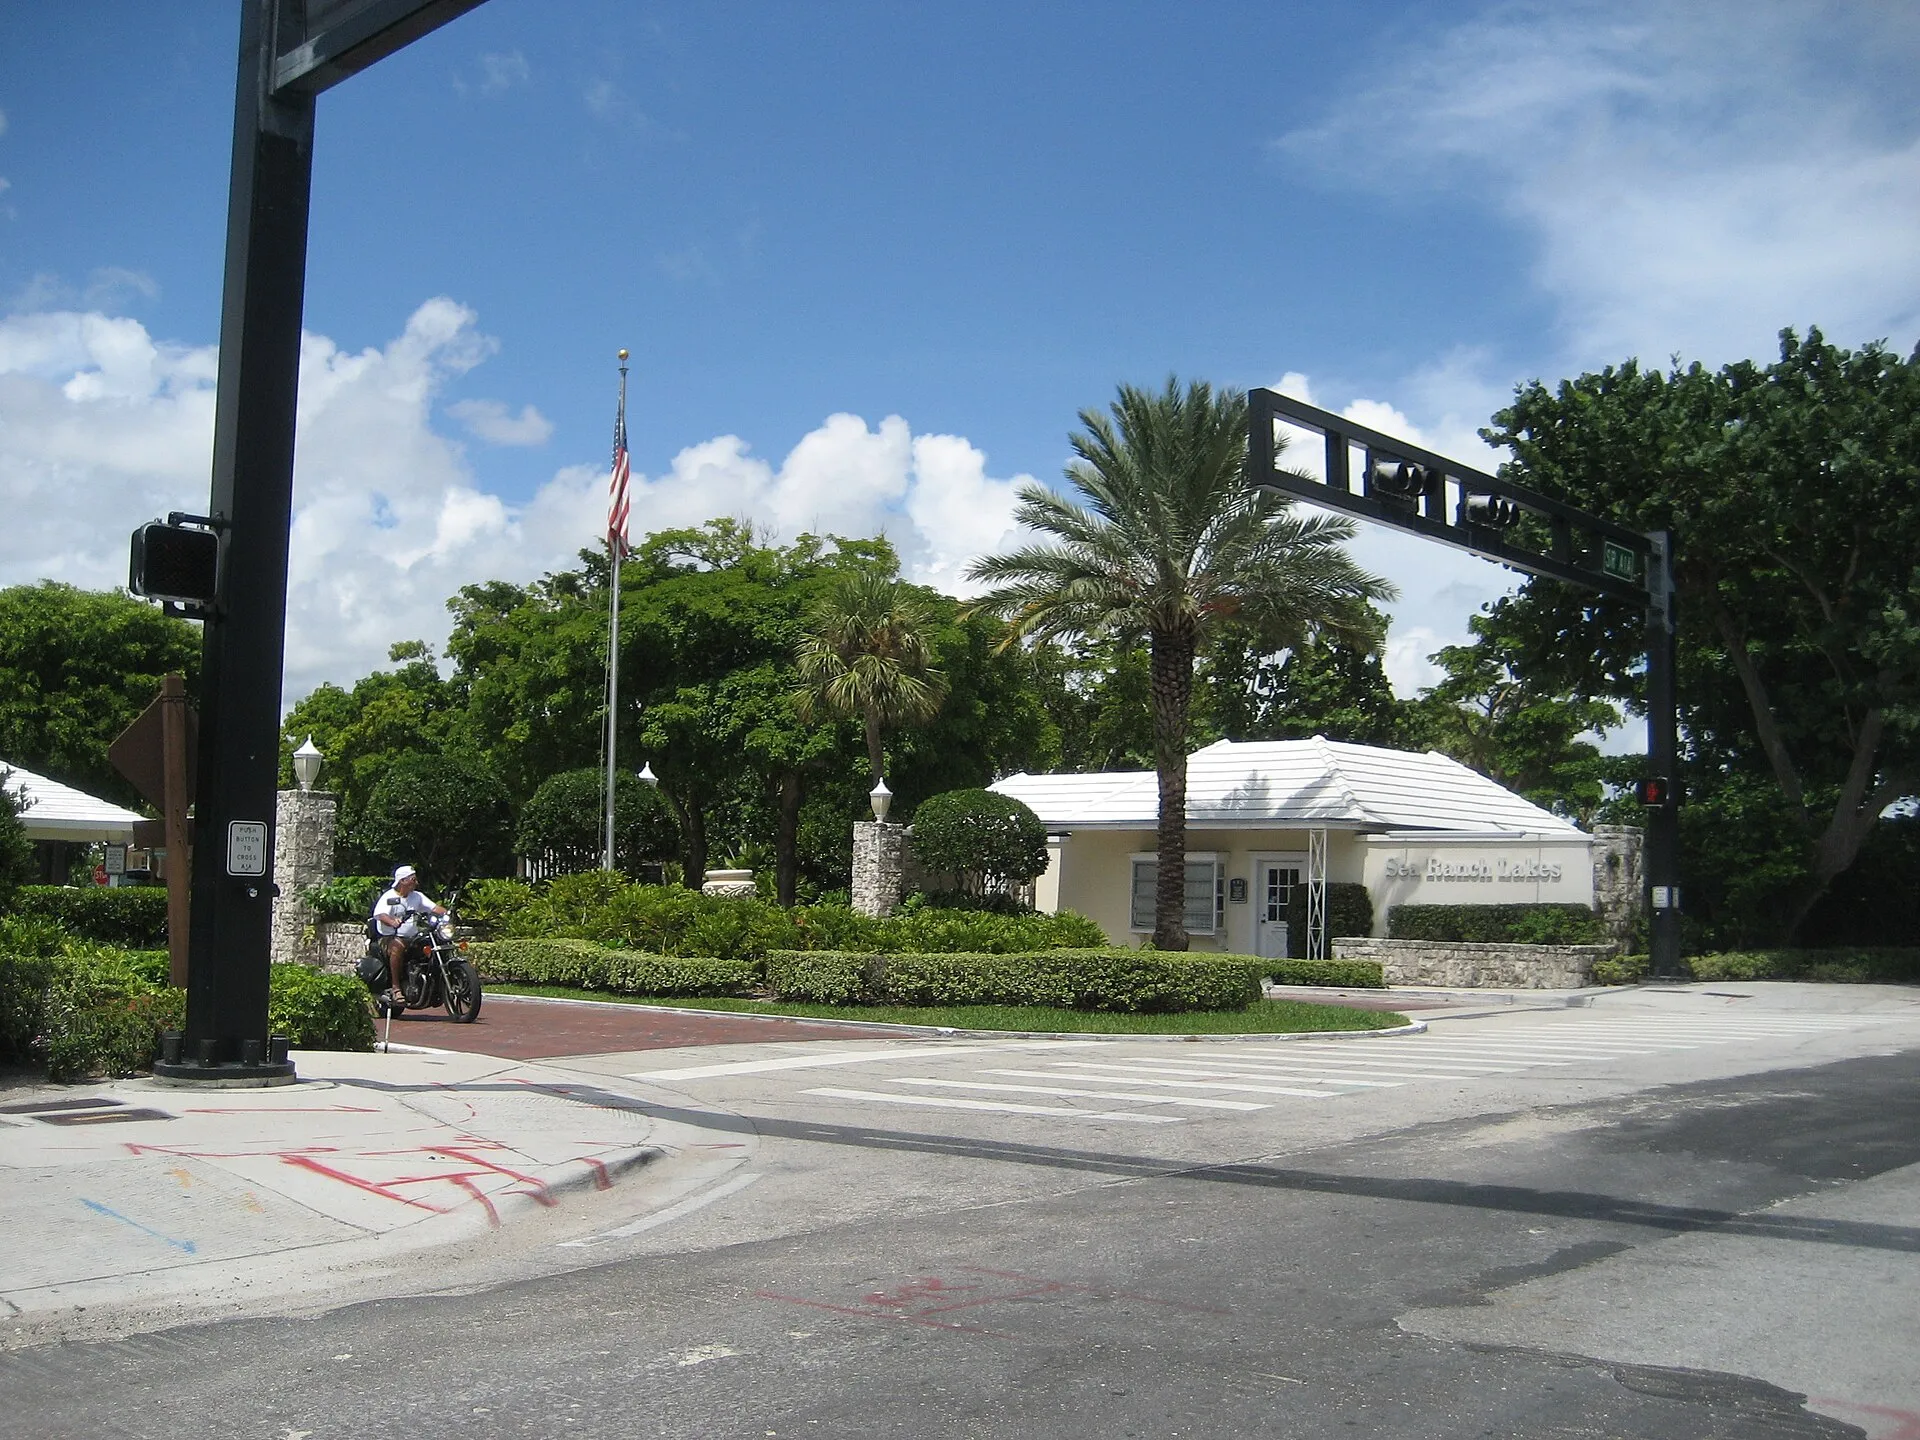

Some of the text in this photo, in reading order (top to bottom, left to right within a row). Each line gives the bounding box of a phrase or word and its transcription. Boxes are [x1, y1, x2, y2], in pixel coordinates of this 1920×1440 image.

[1385, 857, 1562, 882] Sea Ranch Lakes
